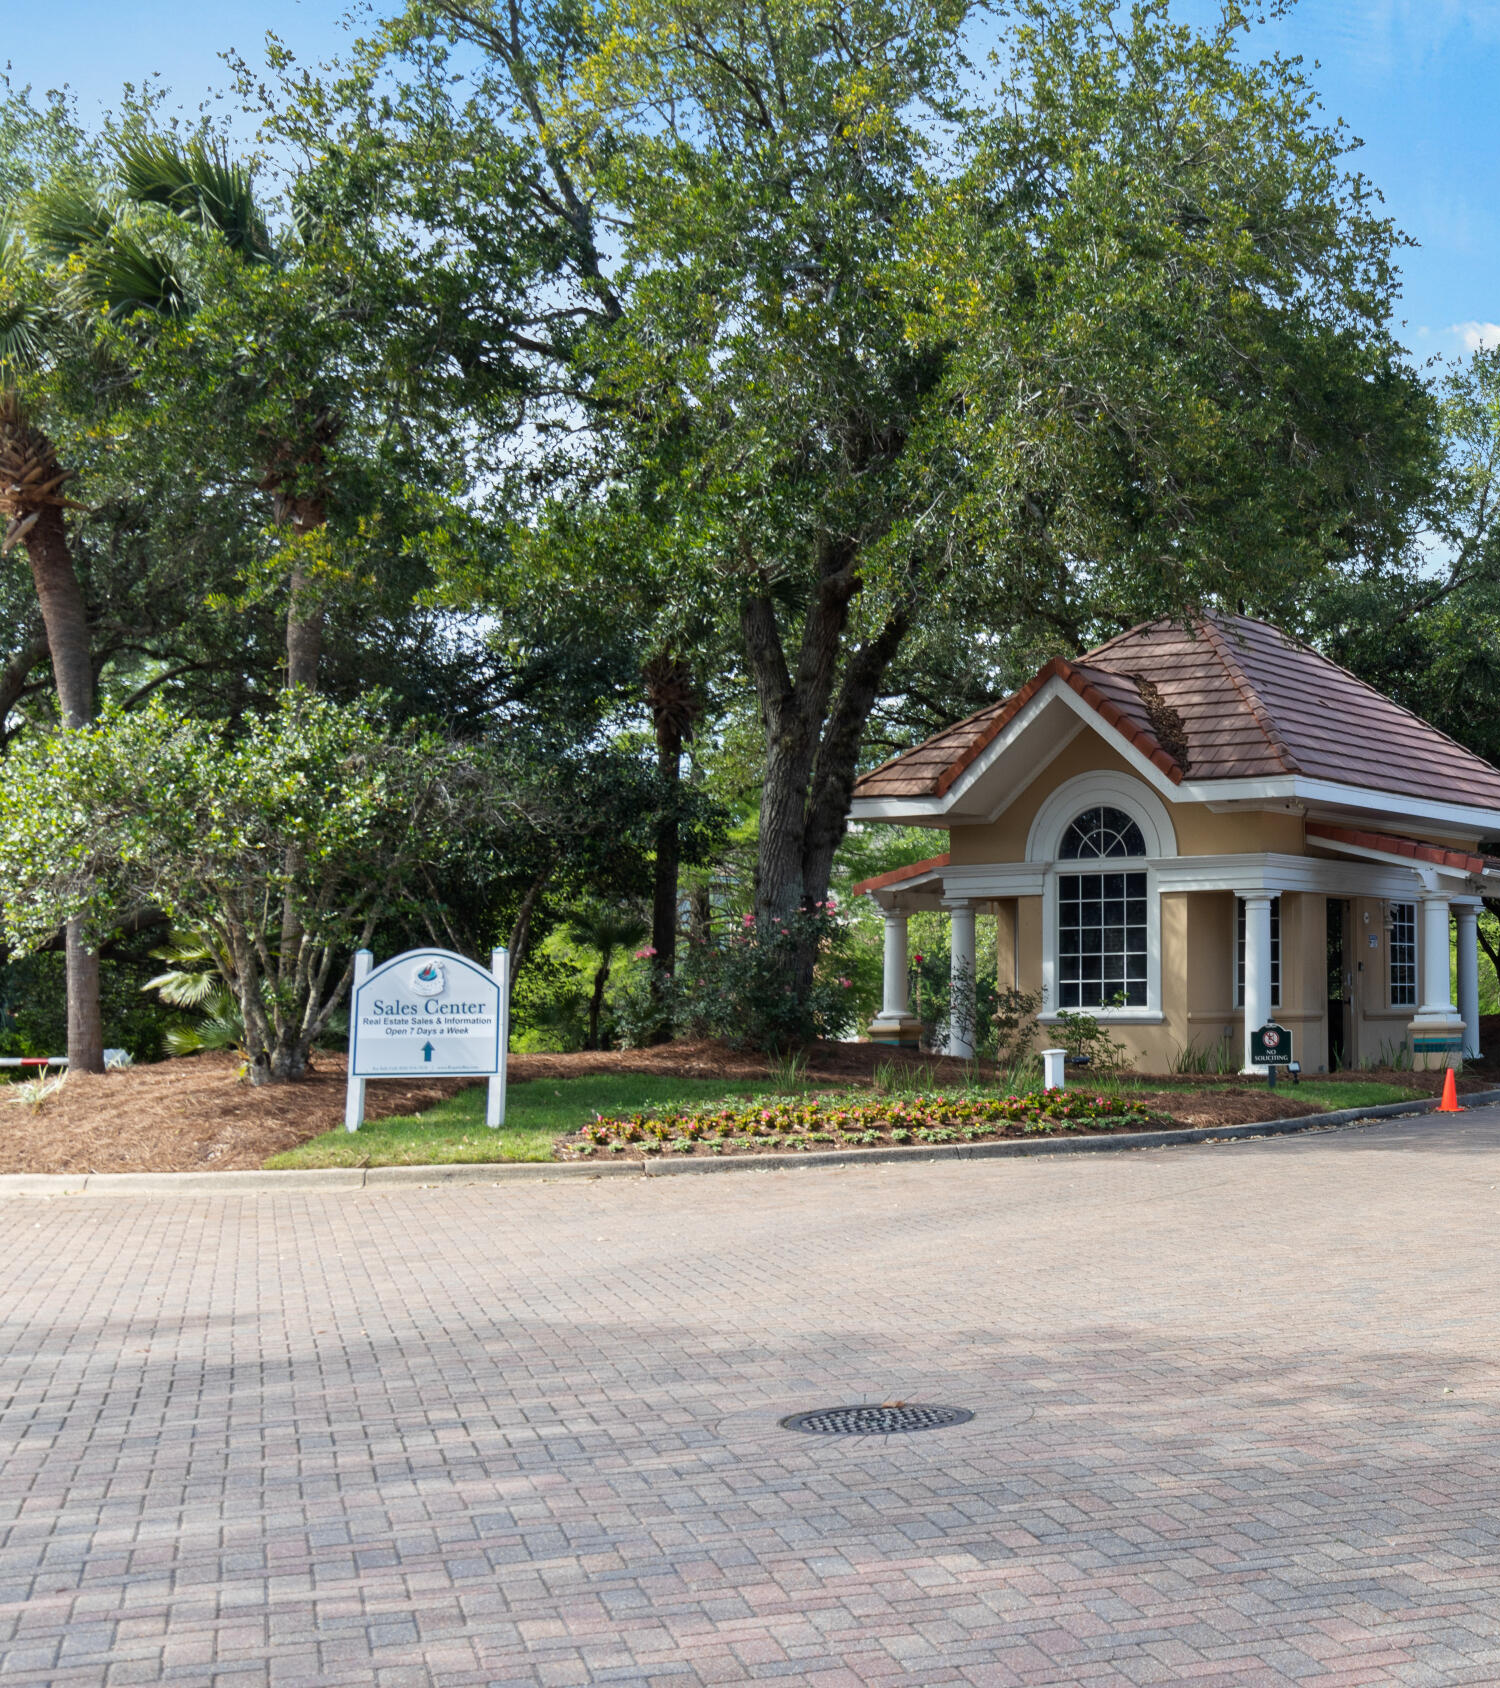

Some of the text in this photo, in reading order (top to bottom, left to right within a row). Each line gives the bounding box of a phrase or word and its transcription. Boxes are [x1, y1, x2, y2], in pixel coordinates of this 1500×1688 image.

[373, 998, 486, 1016] Sales Center
[363, 1016, 492, 1025] Real Estate Sales & Information
[385, 1027, 407, 1036] Open
[410, 1027, 415, 1035] 7
[416, 1027, 437, 1036] Days
[447, 1027, 469, 1035] Week
